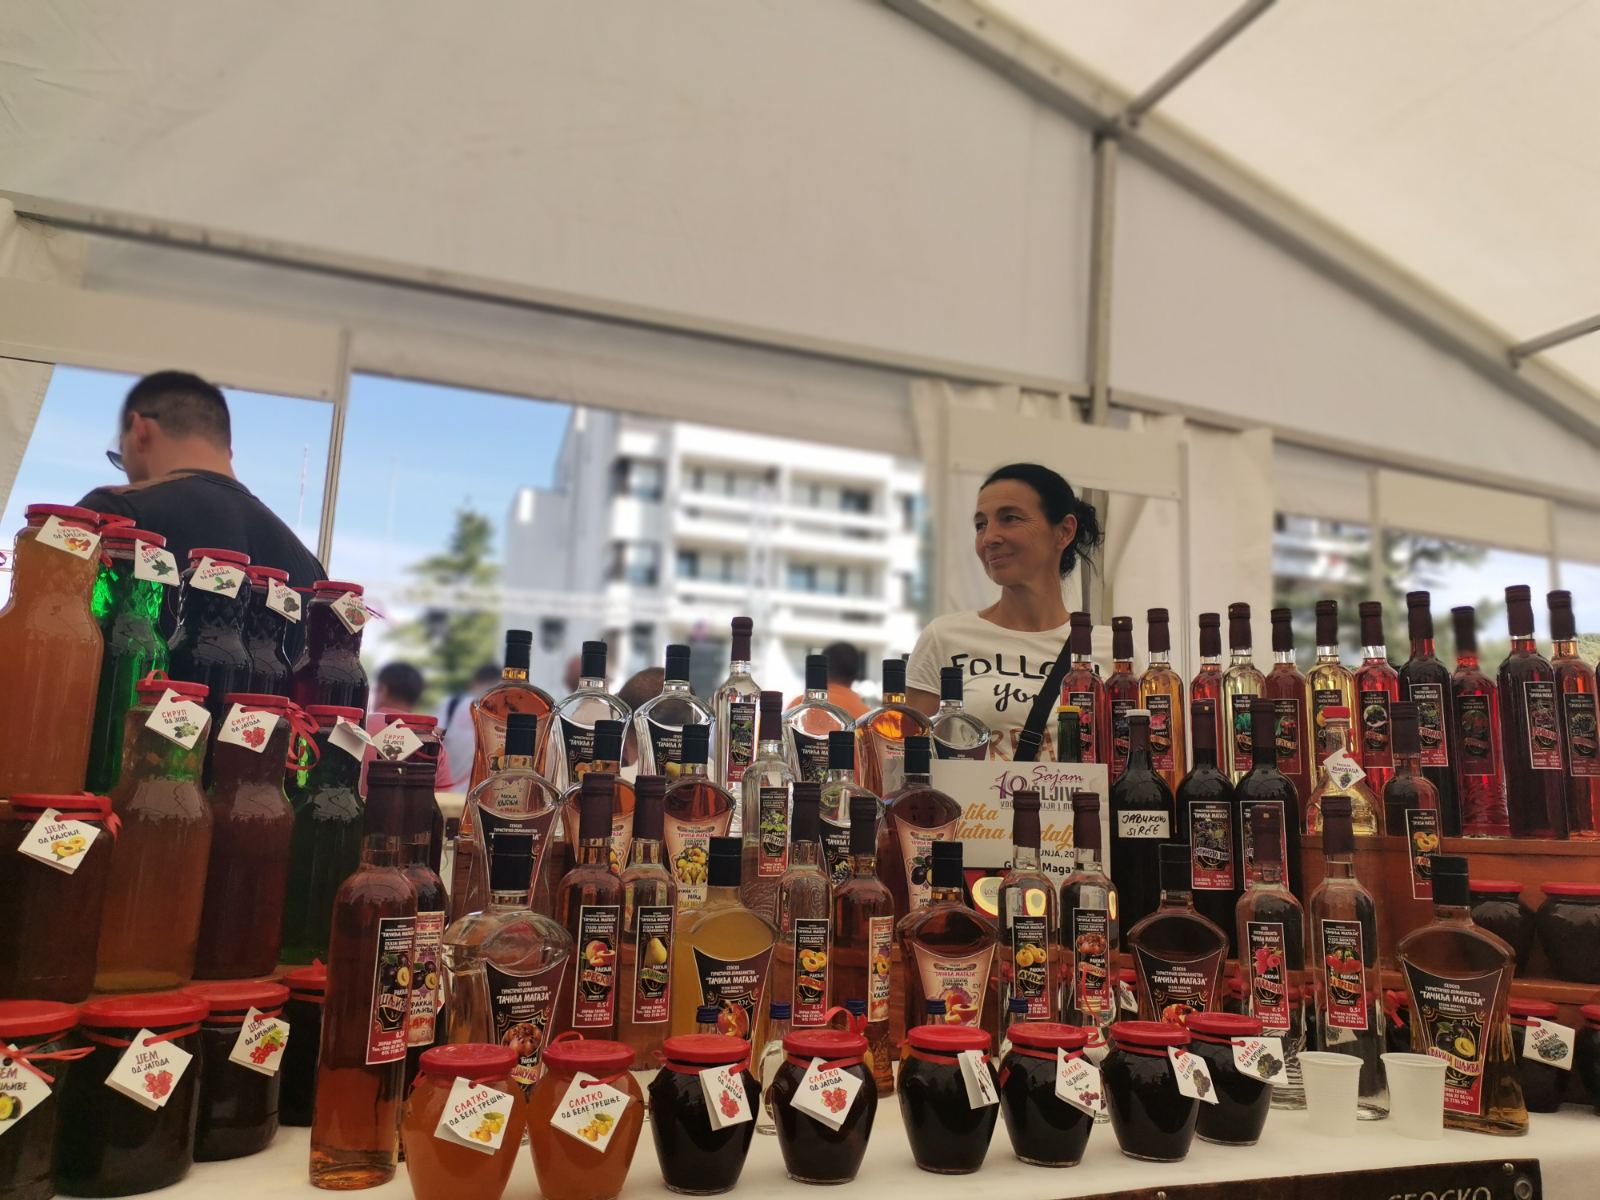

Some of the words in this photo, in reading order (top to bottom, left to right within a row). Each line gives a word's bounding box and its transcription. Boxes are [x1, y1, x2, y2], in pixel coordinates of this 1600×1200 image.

[162, 709, 188, 719] СИРУП
[231, 714, 256, 727] СИРУП
[1032, 765, 1084, 791] Sajam
[44, 823, 68, 835] ЏЕМ
[38, 837, 49, 845] ОД
[136, 1050, 160, 1065] ЏЕМ
[131, 1065, 142, 1074] ОД
[143, 1057, 170, 1071] ЈАГОДА
[0, 1067, 17, 1080] ЕМ
[808, 1069, 840, 1084] СЛАТКО
[809, 1084, 820, 1092] ОД
[820, 1076, 843, 1089] ЈАГОДА
[454, 1090, 489, 1114] СЛАТКО
[561, 1111, 571, 1119] ОД
[572, 1104, 591, 1117] БЕЛЕ
[591, 1095, 621, 1111] ТРЕШЊЕ
[568, 1090, 604, 1109] СЛАТКО
[449, 1116, 460, 1126] ОД
[460, 1108, 478, 1123] БЕЛЕ
